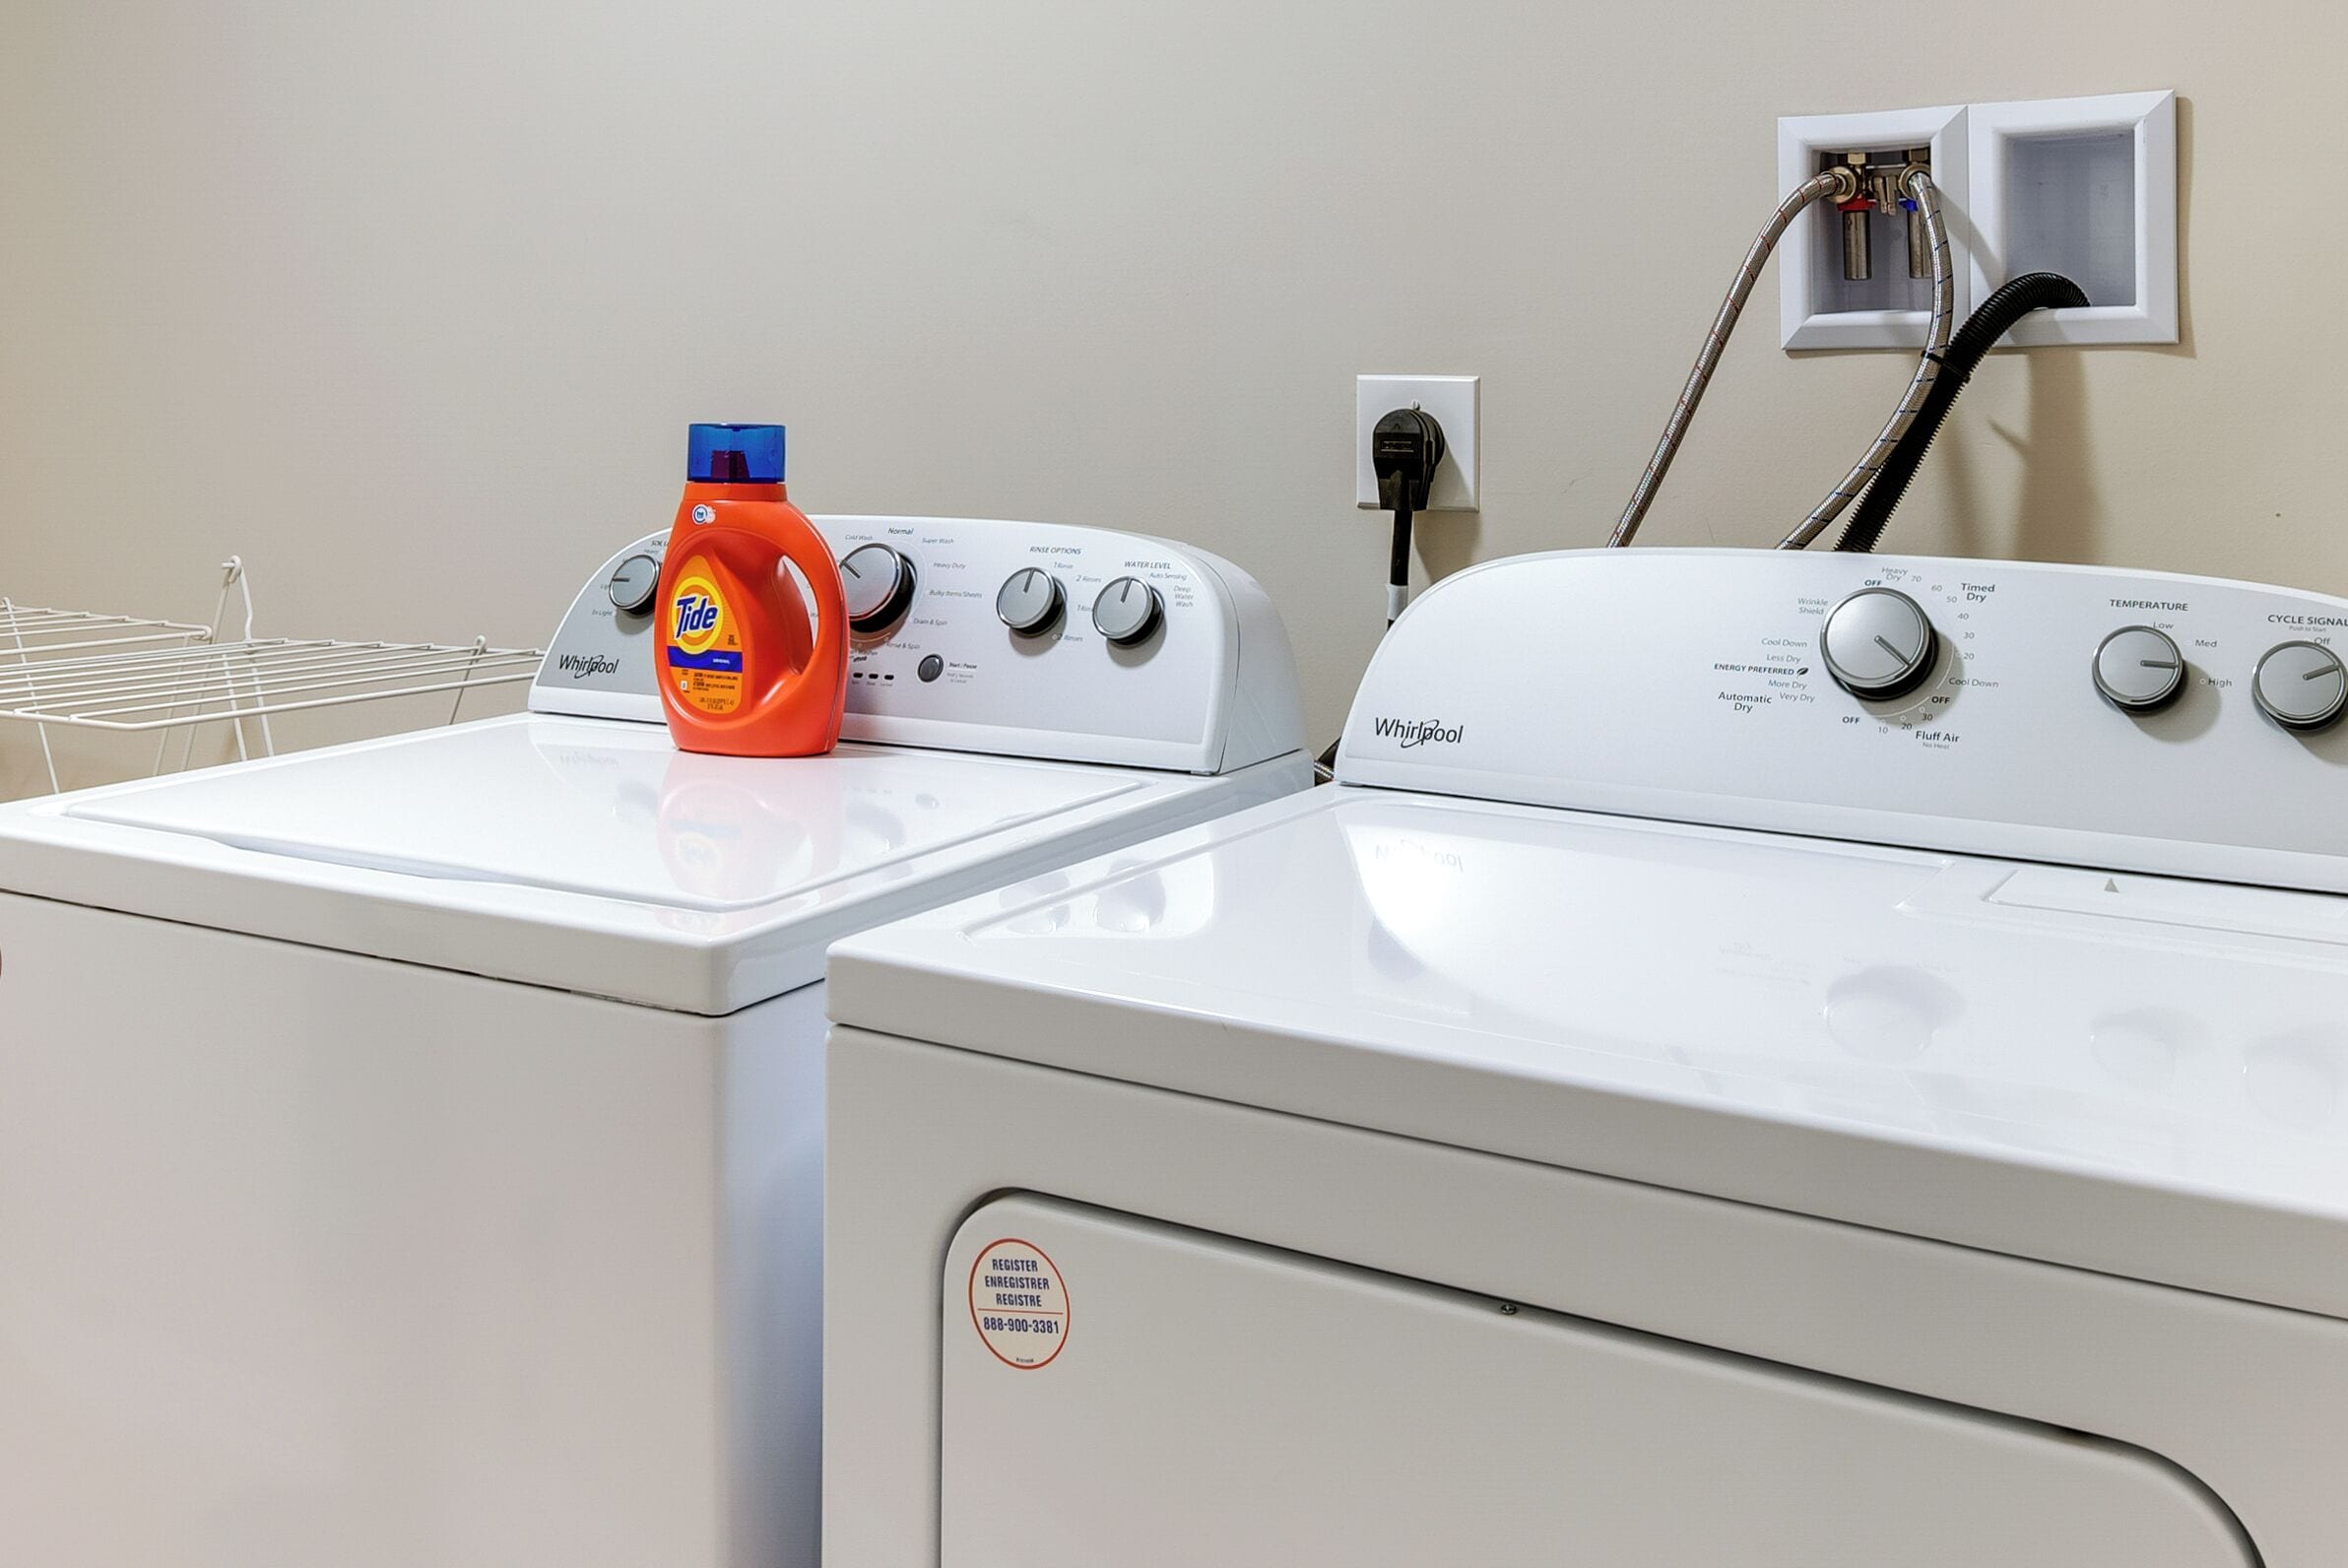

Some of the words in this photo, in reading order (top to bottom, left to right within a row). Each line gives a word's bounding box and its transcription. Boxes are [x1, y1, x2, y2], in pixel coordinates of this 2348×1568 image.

[1881, 567, 1909, 576] Heavy
[1961, 583, 1995, 592] Timed
[1966, 593, 1987, 603] Dry
[2110, 599, 2188, 612] TEMPERATURE
[675, 595, 718, 639] Tide
[2267, 615, 2305, 624] CYCLE
[2153, 621, 2174, 630] Low
[1782, 639, 1807, 648] Down
[2194, 639, 2217, 648] Med
[1786, 655, 1801, 665] Dry
[558, 654, 620, 679] Whirlpool
[1714, 663, 1747, 672] ENERGY
[1747, 665, 1794, 676] PREFERRED
[1792, 681, 1807, 690] Dry
[1948, 677, 1971, 686] Cool
[1972, 679, 1998, 687] Down
[2207, 678, 2232, 688] High
[1718, 691, 1773, 704] Automatic
[1779, 692, 1798, 702] Very
[1799, 693, 1815, 703] Dry
[1733, 702, 1753, 713] Dry
[1375, 717, 1464, 749] Whirlpool
[1915, 730, 1941, 742] Fluff
[1942, 733, 1960, 743] Air
[992, 1259, 1038, 1272] REGISTER
[984, 1274, 1050, 1290] ENREGISTRER
[996, 1293, 1042, 1307] REGISTRE
[983, 1316, 1059, 1335] 888-900-3381
